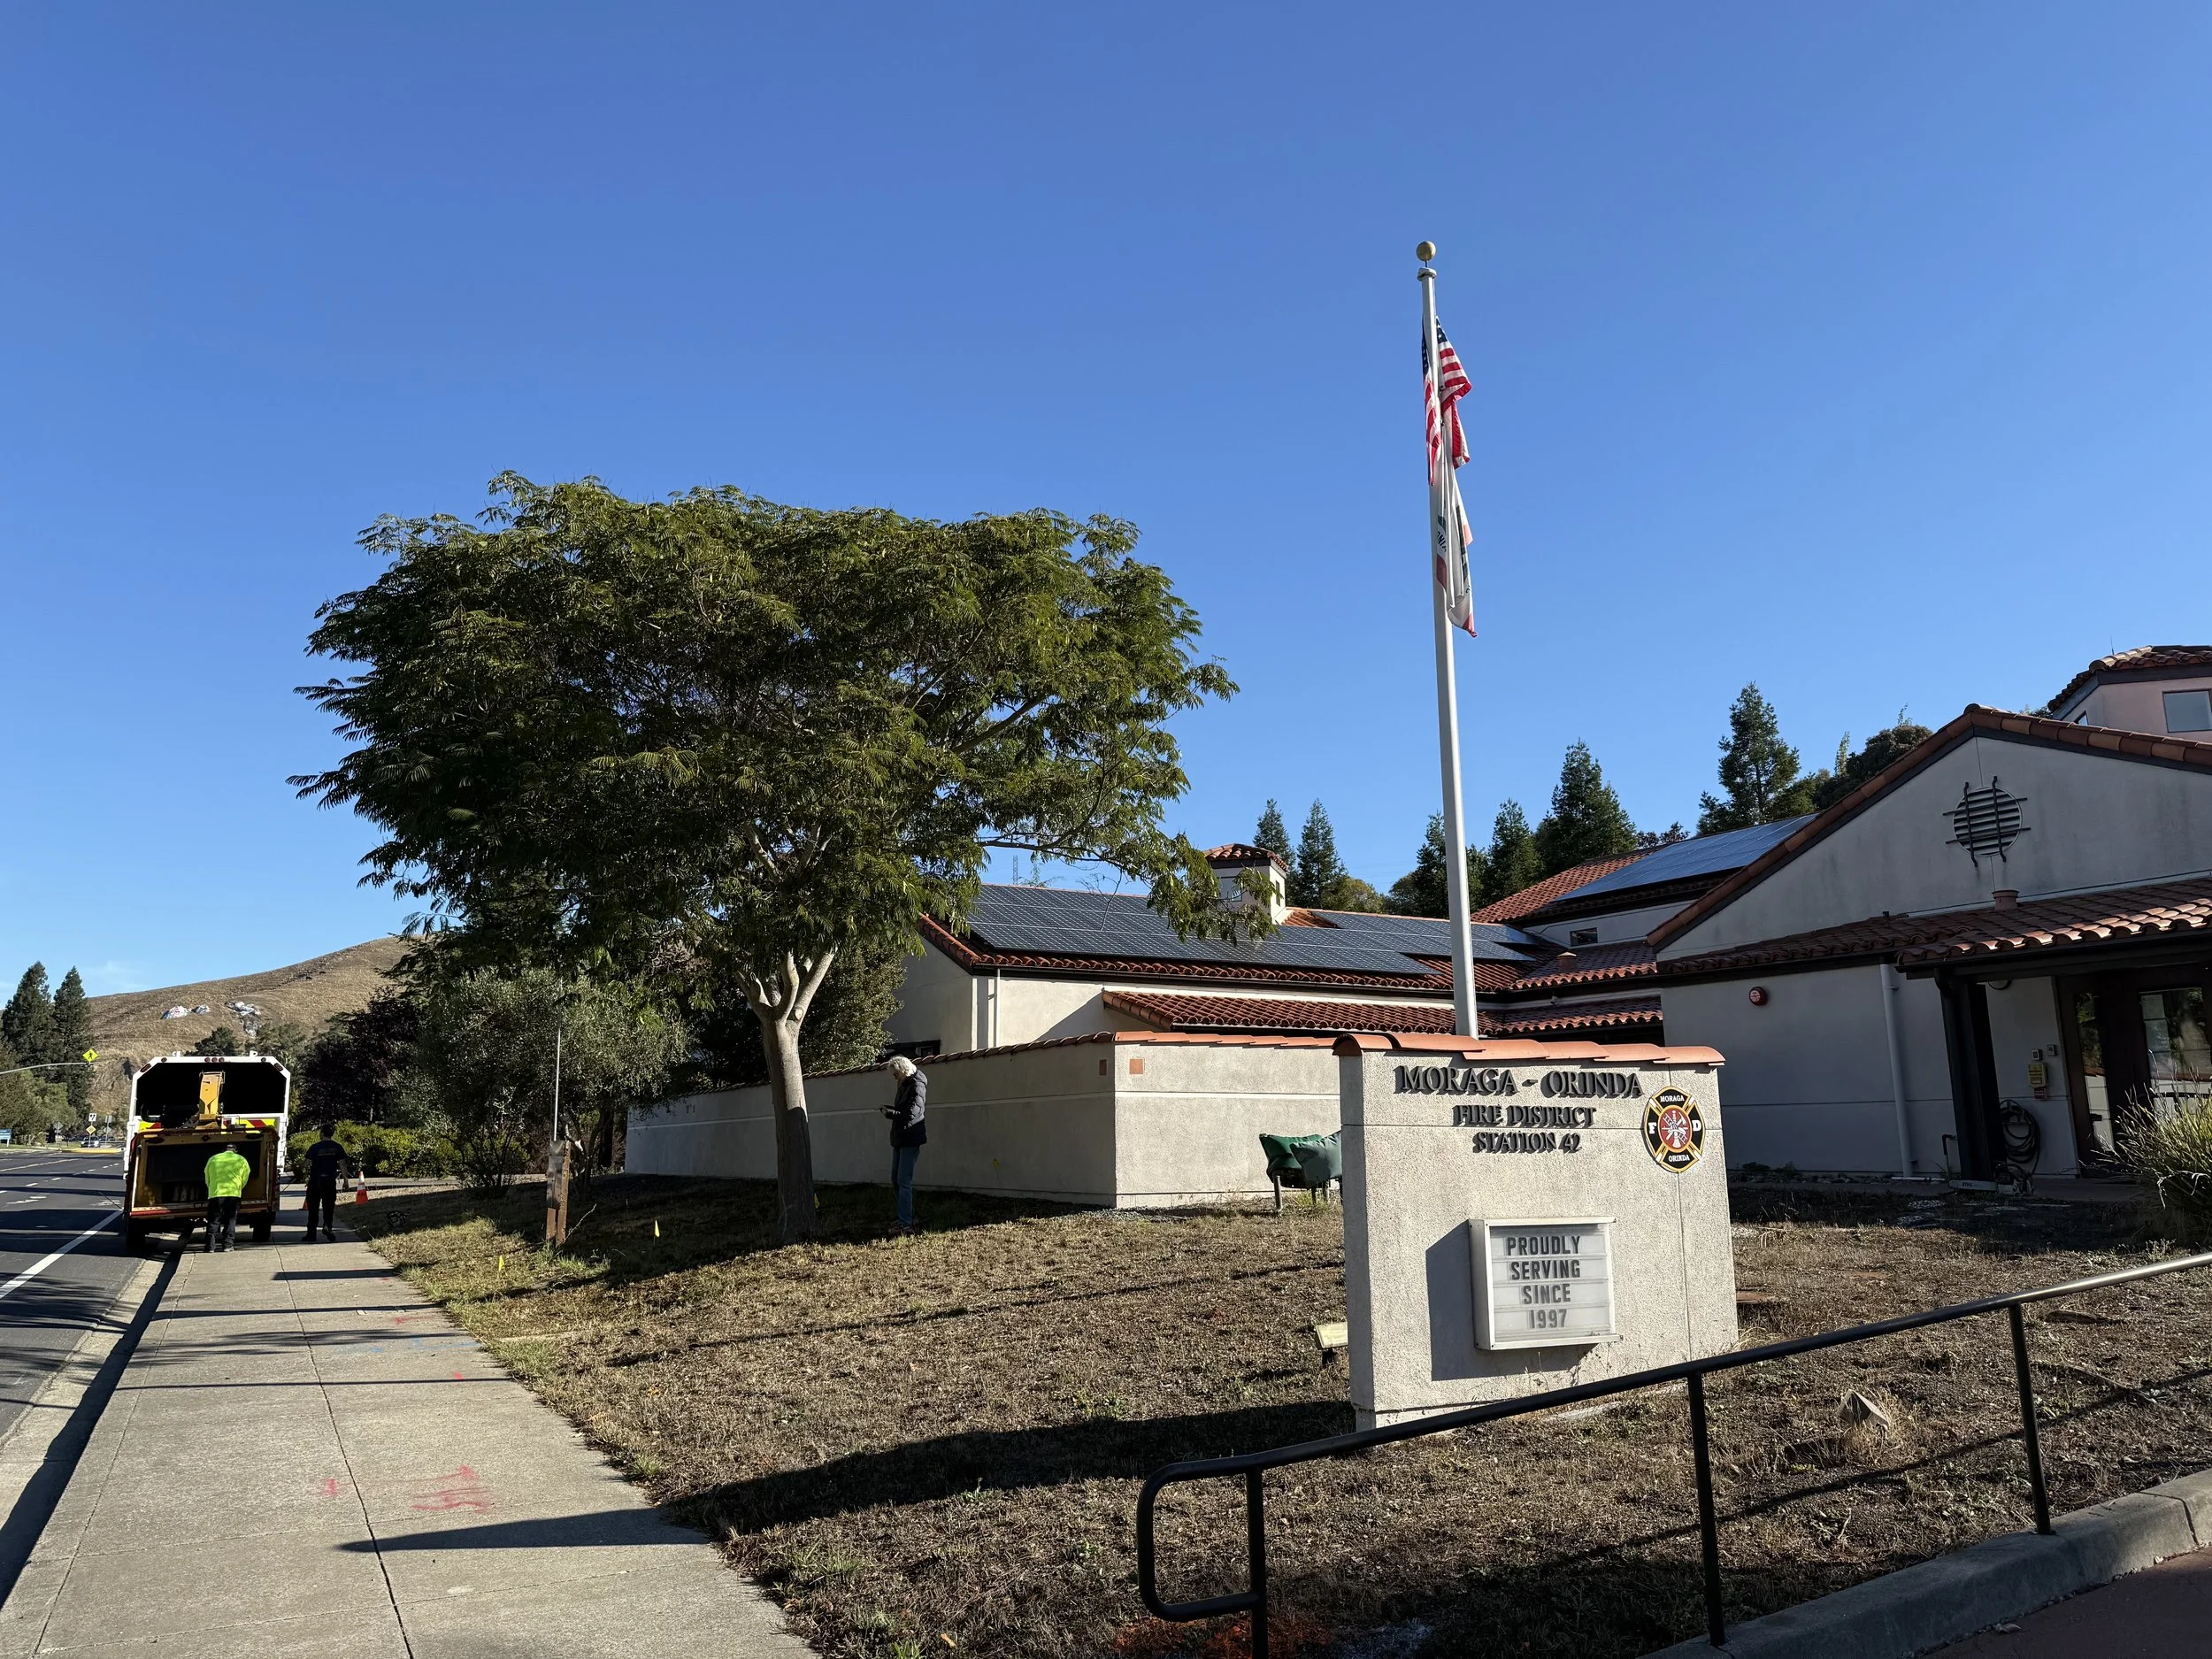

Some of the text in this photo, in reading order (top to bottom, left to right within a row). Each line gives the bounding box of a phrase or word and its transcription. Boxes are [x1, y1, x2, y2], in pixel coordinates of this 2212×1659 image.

[1400, 1065, 1519, 1094] MORAGA
[1548, 1071, 1645, 1096] ORINDA
[1458, 1104, 1596, 1125] FIRE DISTRICT
[1647, 1122, 1657, 1134] F
[1692, 1119, 1701, 1132] D
[1476, 1132, 1582, 1151] STATION 42
[1668, 1154, 1690, 1163] ORINDA
[1507, 1235, 1580, 1256] PROUDLY
[1510, 1259, 1580, 1280] SERVING
[1523, 1283, 1571, 1304] SINCE
[1530, 1309, 1567, 1329] 1997
